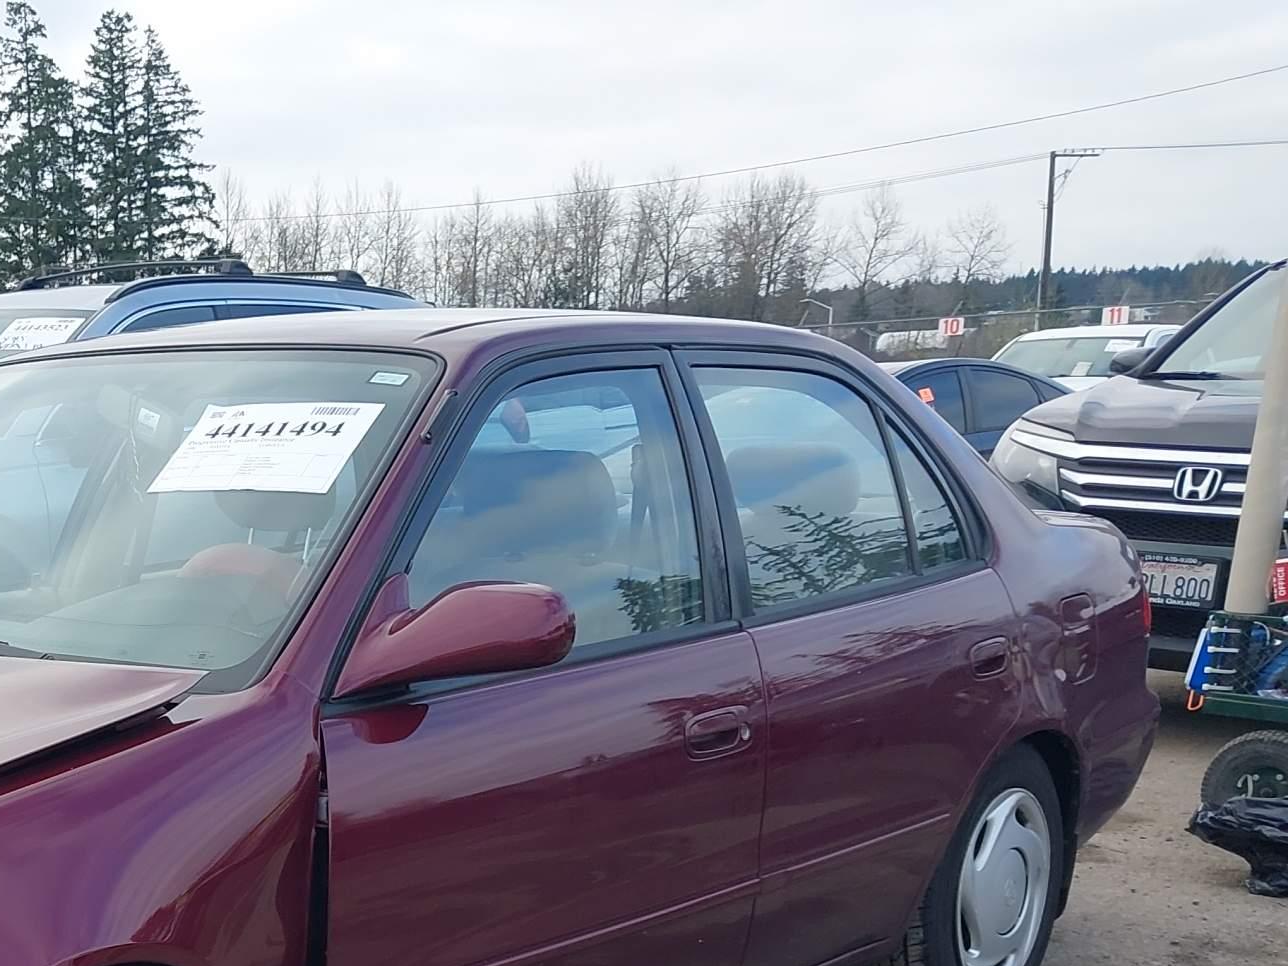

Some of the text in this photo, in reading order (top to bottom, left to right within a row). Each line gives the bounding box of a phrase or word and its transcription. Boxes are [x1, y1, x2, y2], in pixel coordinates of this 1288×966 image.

[1108, 307, 1122, 323] 11
[943, 319, 959, 335] 10
[204, 420, 346, 439] 44141494
[1276, 567, 1287, 597] OFFICE
